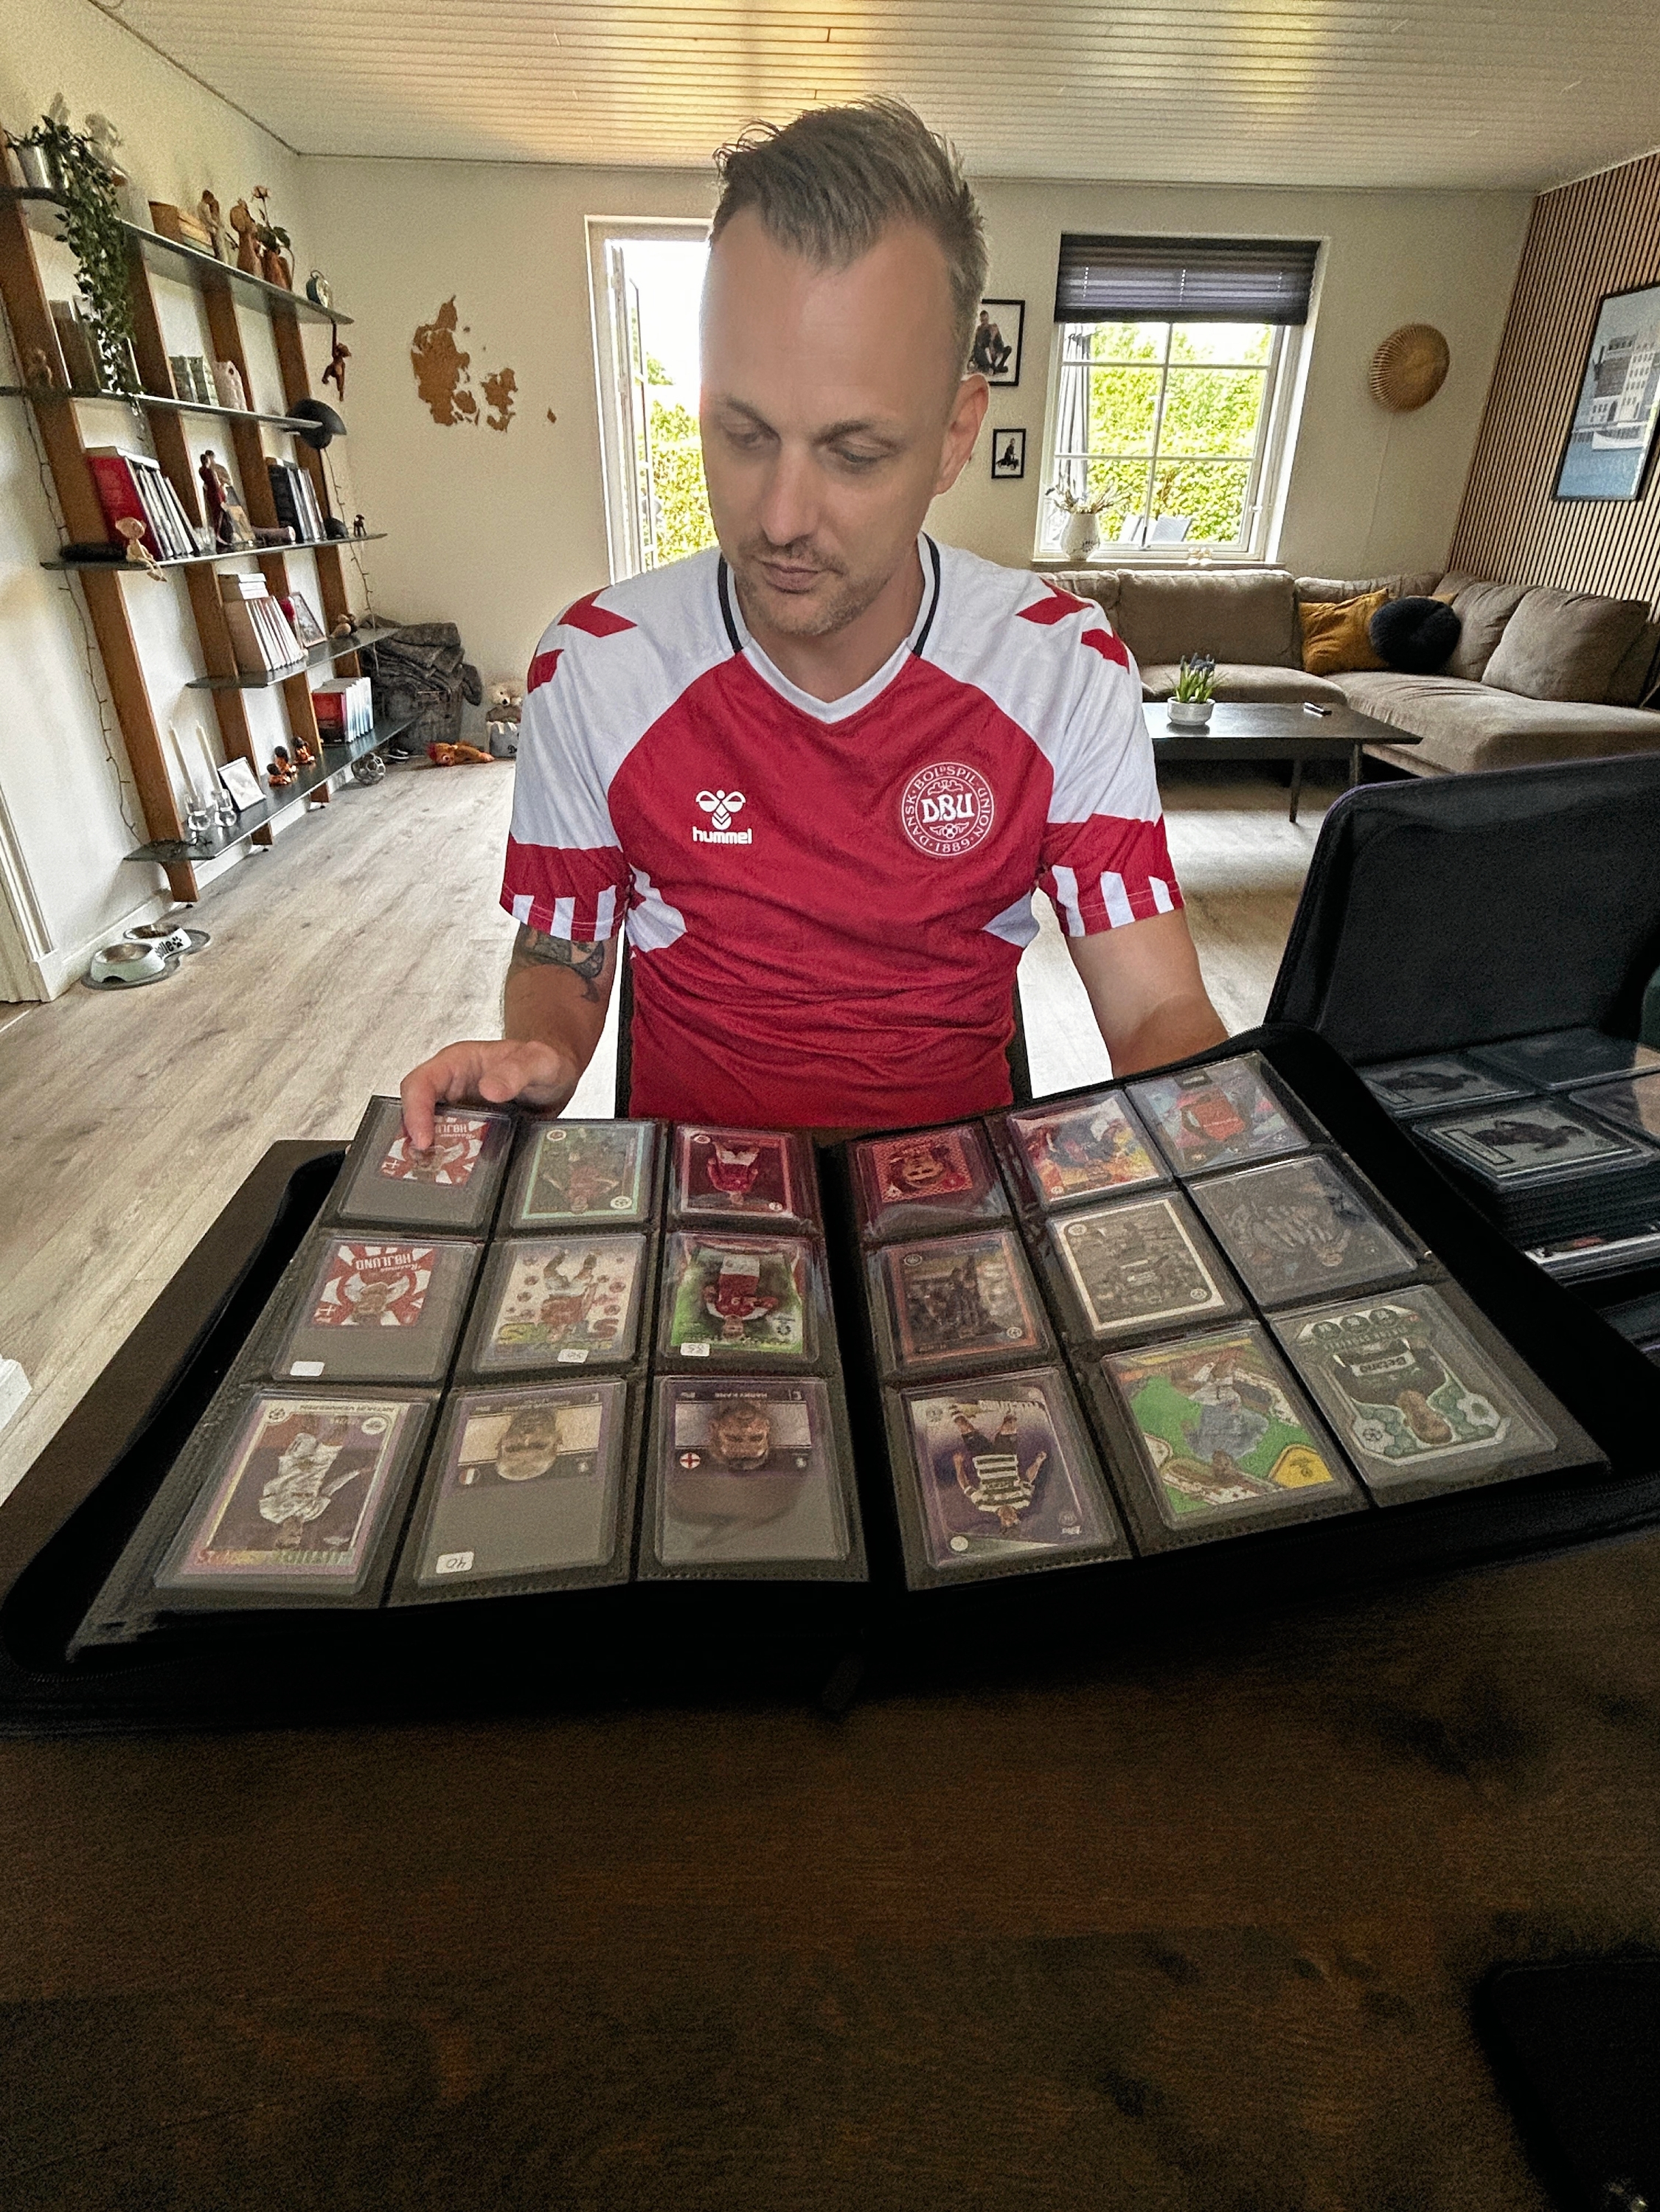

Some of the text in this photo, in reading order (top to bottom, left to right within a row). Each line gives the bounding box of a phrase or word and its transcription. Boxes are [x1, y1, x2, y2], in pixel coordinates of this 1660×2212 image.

[905, 794, 930, 846] DANSK
[972, 787, 991, 838] UNION
[920, 793, 976, 824] DBU
[692, 826, 753, 845] hummel
[935, 838, 970, 853] 1889
[434, 1123, 468, 1134] HØJLU
